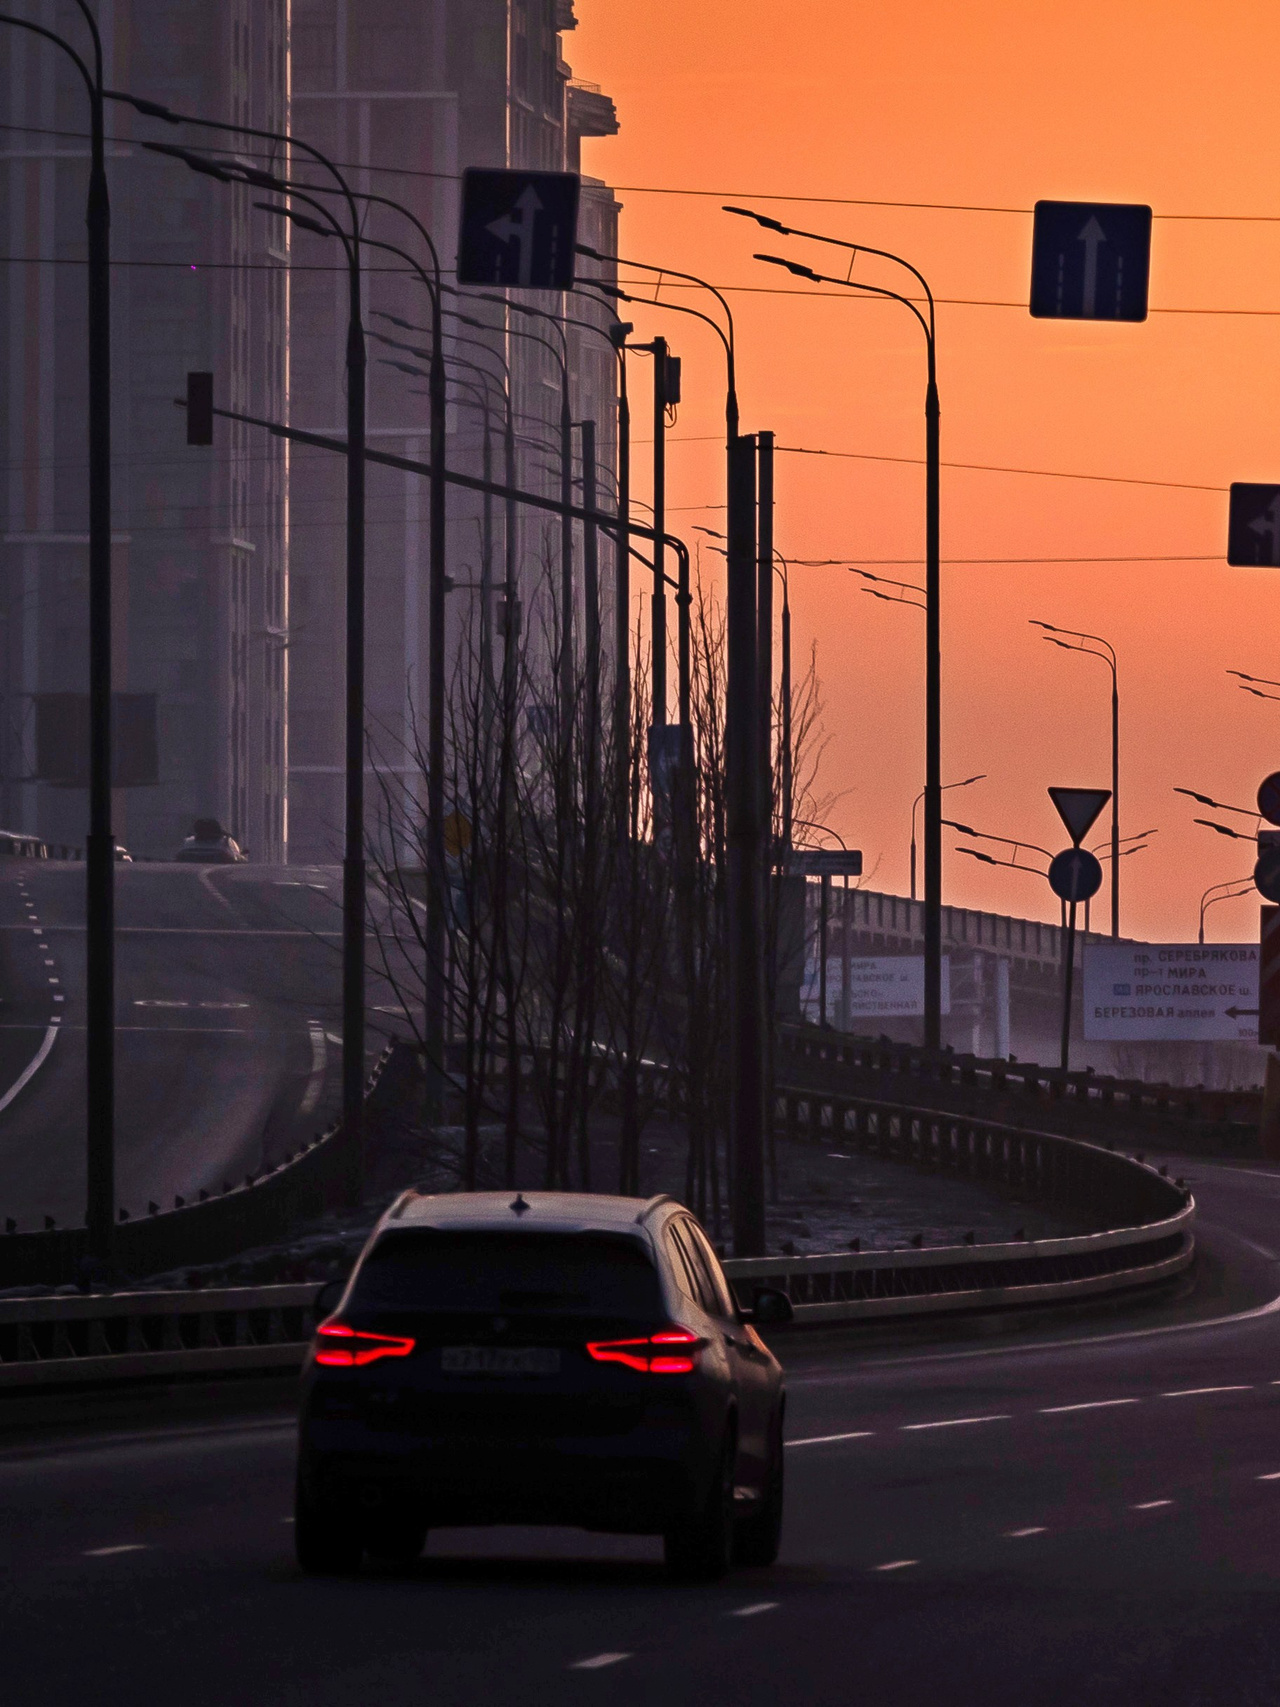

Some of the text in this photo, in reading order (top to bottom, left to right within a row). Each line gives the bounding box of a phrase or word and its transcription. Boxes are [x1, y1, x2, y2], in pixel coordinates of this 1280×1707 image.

[1134, 950, 1257, 964] пр. СЕРЕБРЯКОВА
[1134, 966, 1207, 979] пр-т МИРА
[1135, 984, 1236, 996] ЯРОСЛАВСКОЕ
[1094, 1007, 1175, 1019] БЕРЕЗОВАЯ
